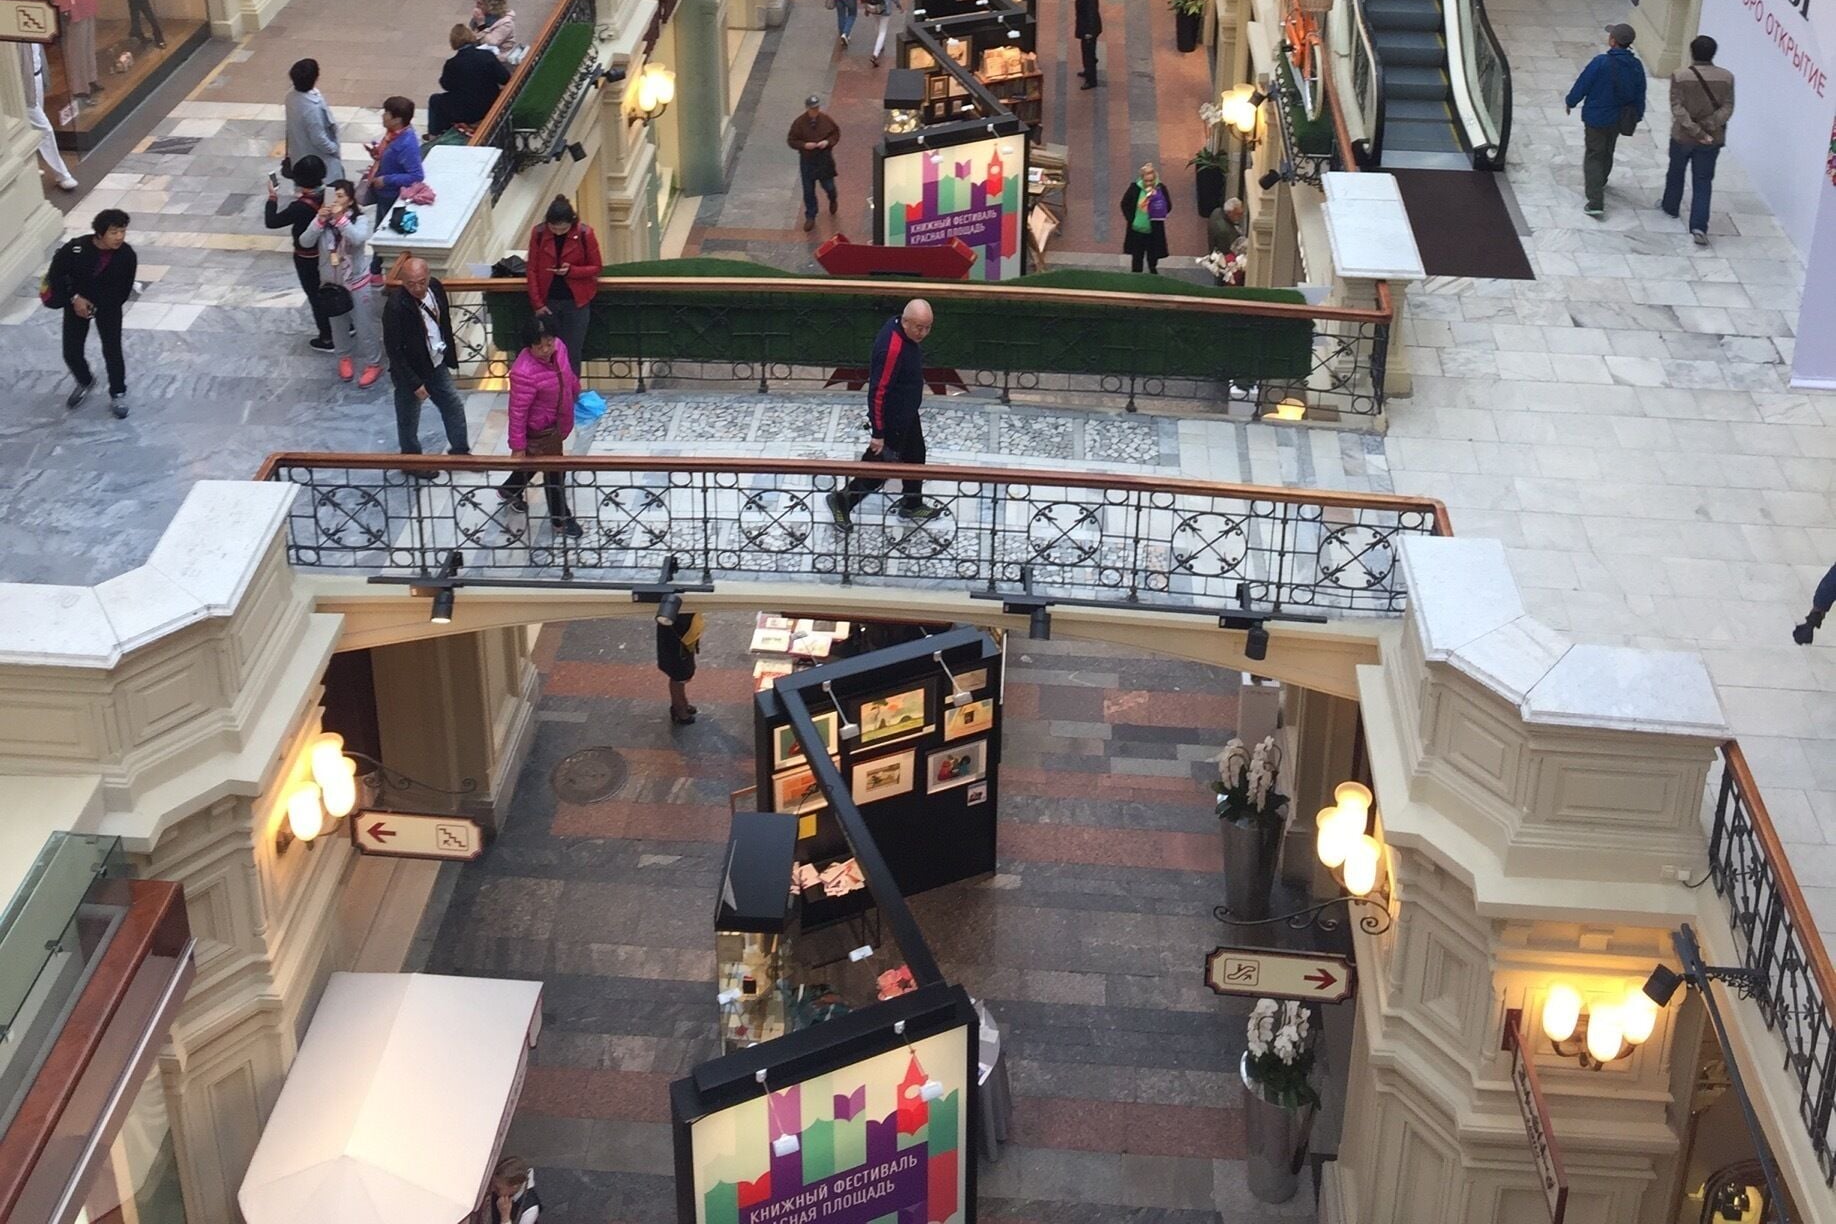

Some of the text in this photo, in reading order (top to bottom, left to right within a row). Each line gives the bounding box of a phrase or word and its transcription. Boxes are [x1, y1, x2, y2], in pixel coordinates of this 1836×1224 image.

[1765, 13, 1827, 98] ОТКРЫТИЕ
[910, 223, 986, 244] КРАСНАЯ ПЛОЩАДЬ
[911, 209, 997, 234] КНИЖНЫЙ ФЕСТИВАЛЬ
[750, 1154, 918, 1224] КНИЖНЫЙ ФЕСТИВАЛЬ
[822, 1180, 896, 1217] ПЛОЩАДЬ
